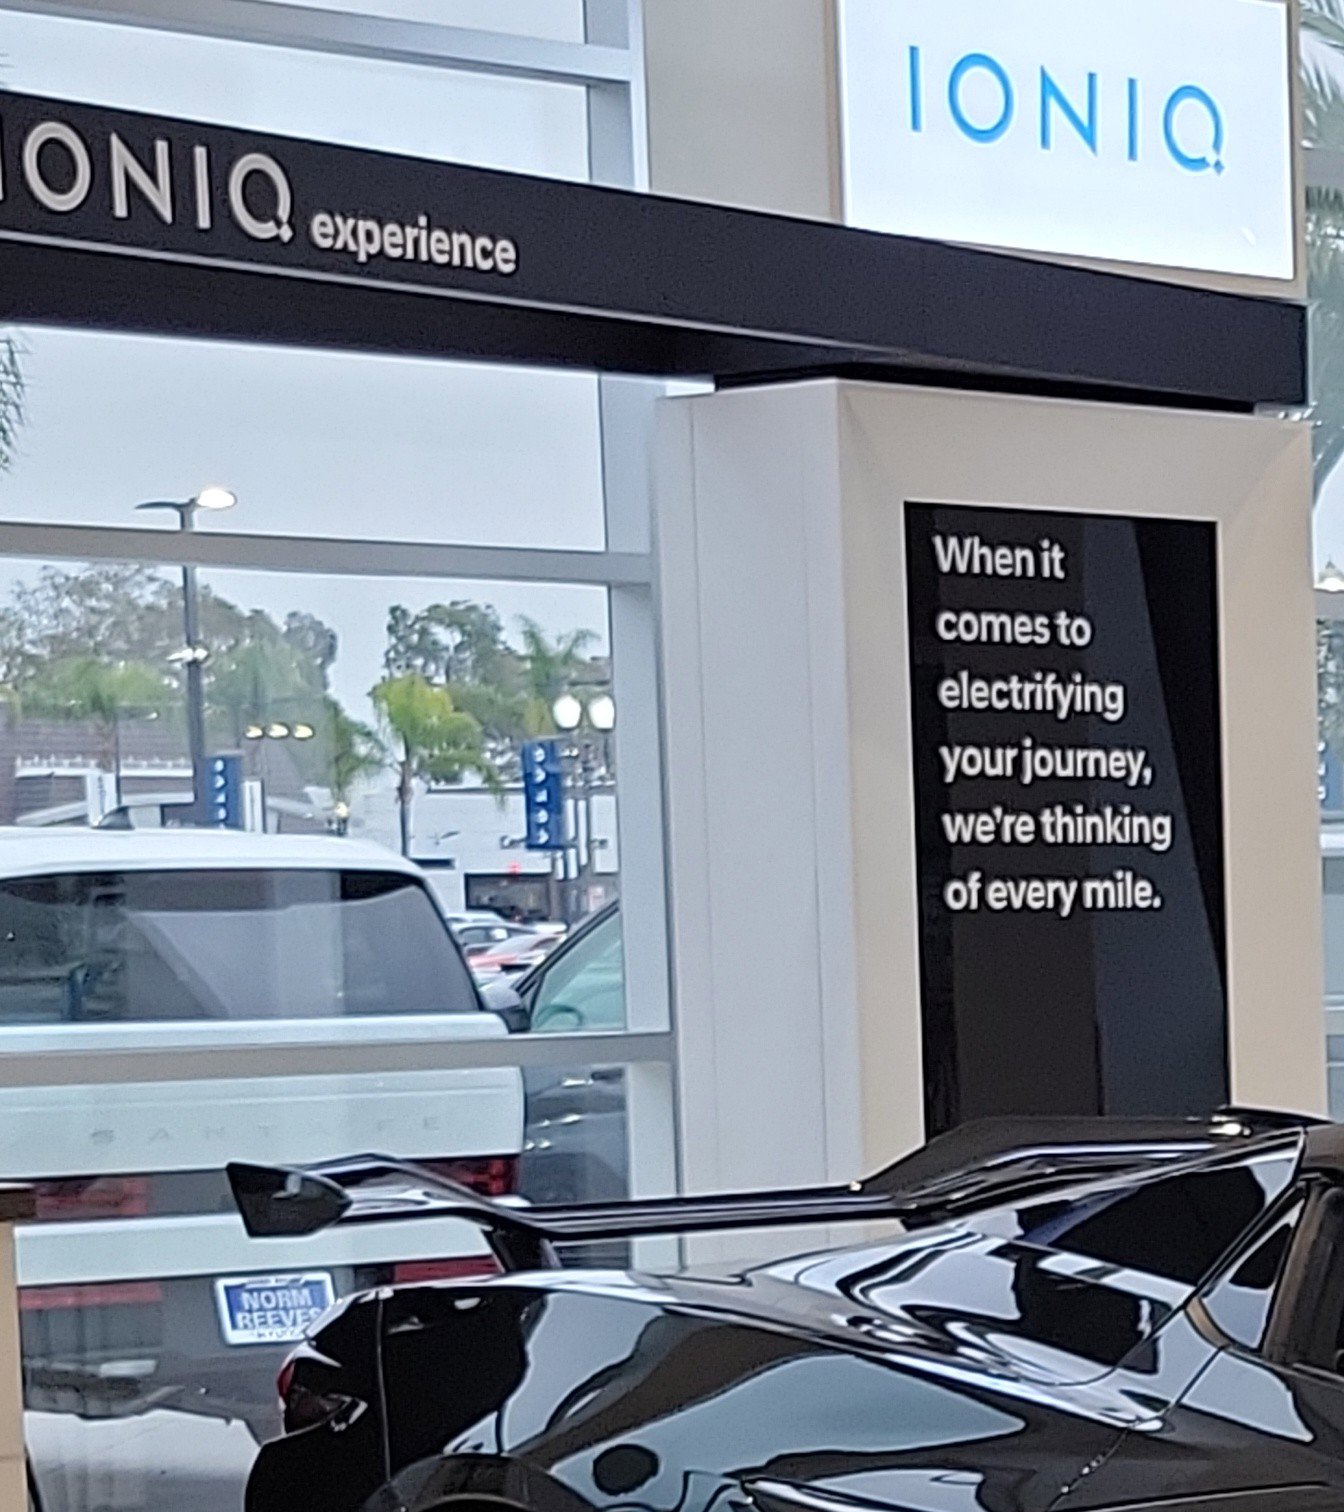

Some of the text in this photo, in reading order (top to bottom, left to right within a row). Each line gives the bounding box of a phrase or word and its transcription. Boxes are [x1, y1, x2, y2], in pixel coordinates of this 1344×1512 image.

[909, 46, 1225, 175] IONIQ
[0, 118, 516, 274] ONIQ experience
[932, 534, 1066, 579] When it
[936, 610, 1092, 646] comes to
[939, 669, 1125, 721] electrifying
[939, 736, 1153, 787] your journey,
[941, 804, 1172, 851] we're thinking
[944, 869, 1162, 917] of every mile.
[241, 1287, 313, 1311] NORM
